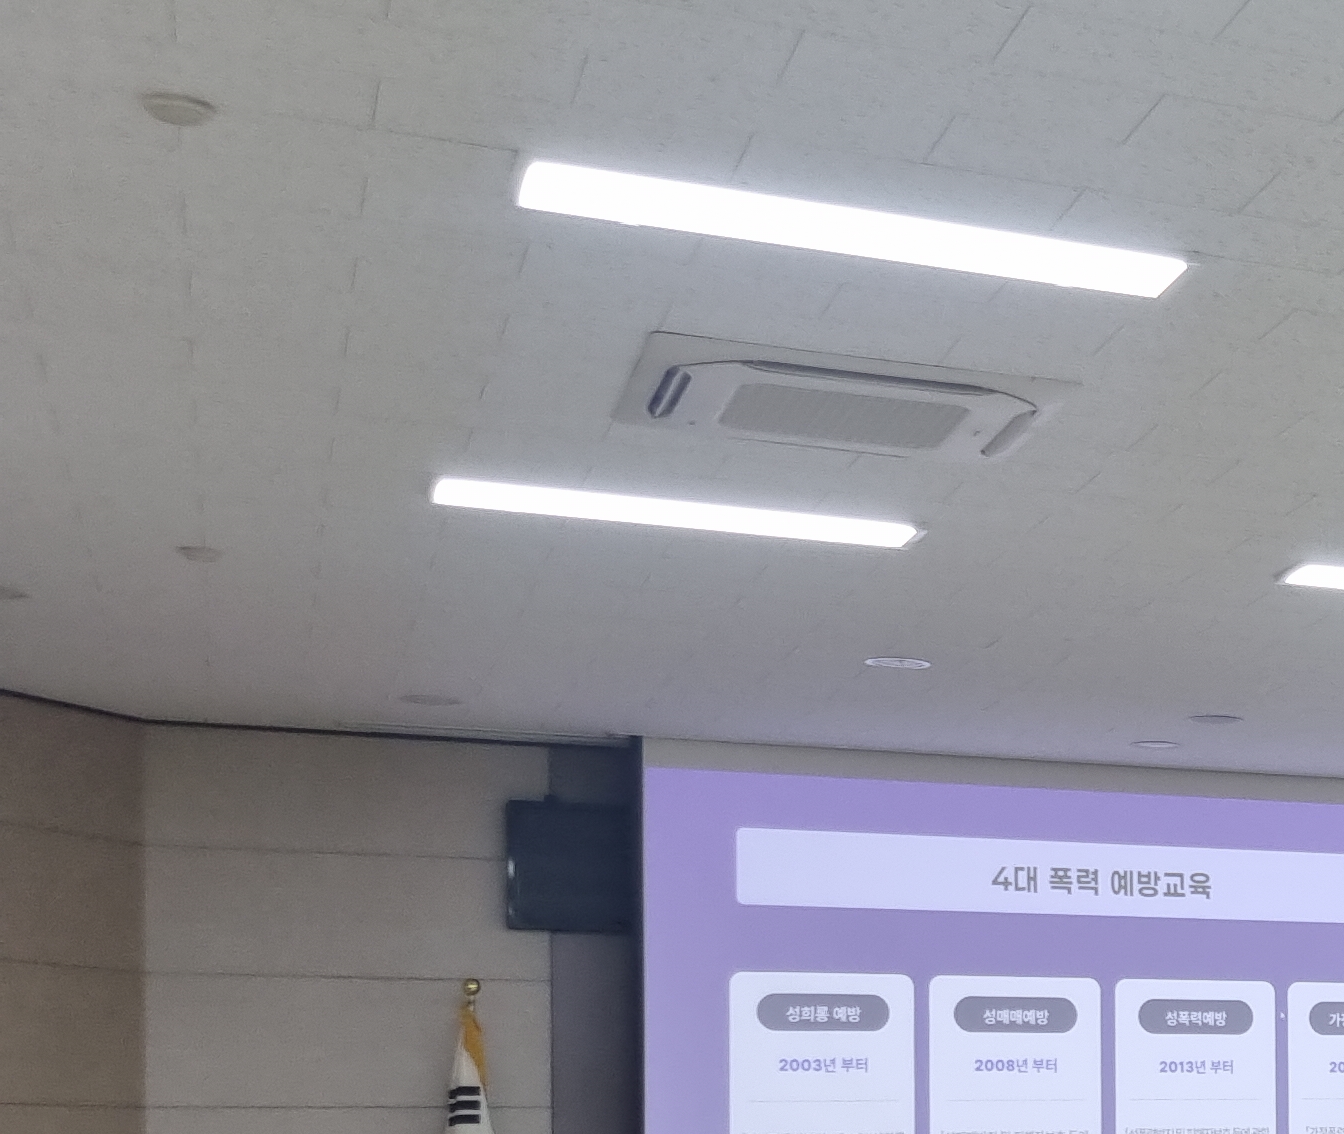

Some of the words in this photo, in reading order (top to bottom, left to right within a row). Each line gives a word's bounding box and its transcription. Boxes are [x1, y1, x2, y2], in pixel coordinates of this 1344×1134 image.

[991, 865, 1038, 894] 4대
[1049, 866, 1099, 896] 폭력
[1110, 869, 1212, 900] 예방교육
[786, 1005, 830, 1023] 성희롱
[832, 1005, 862, 1023] 예방
[983, 1008, 1050, 1026] 성매매예방
[1165, 1010, 1228, 1027] 성폭력예방
[778, 1057, 836, 1074] 2003년
[840, 1057, 869, 1074] 부터
[974, 1058, 1029, 1074] 2008년
[1032, 1057, 1058, 1074] 부터
[1159, 1060, 1206, 1075] 2013년
[1209, 1060, 1234, 1075] 부터
